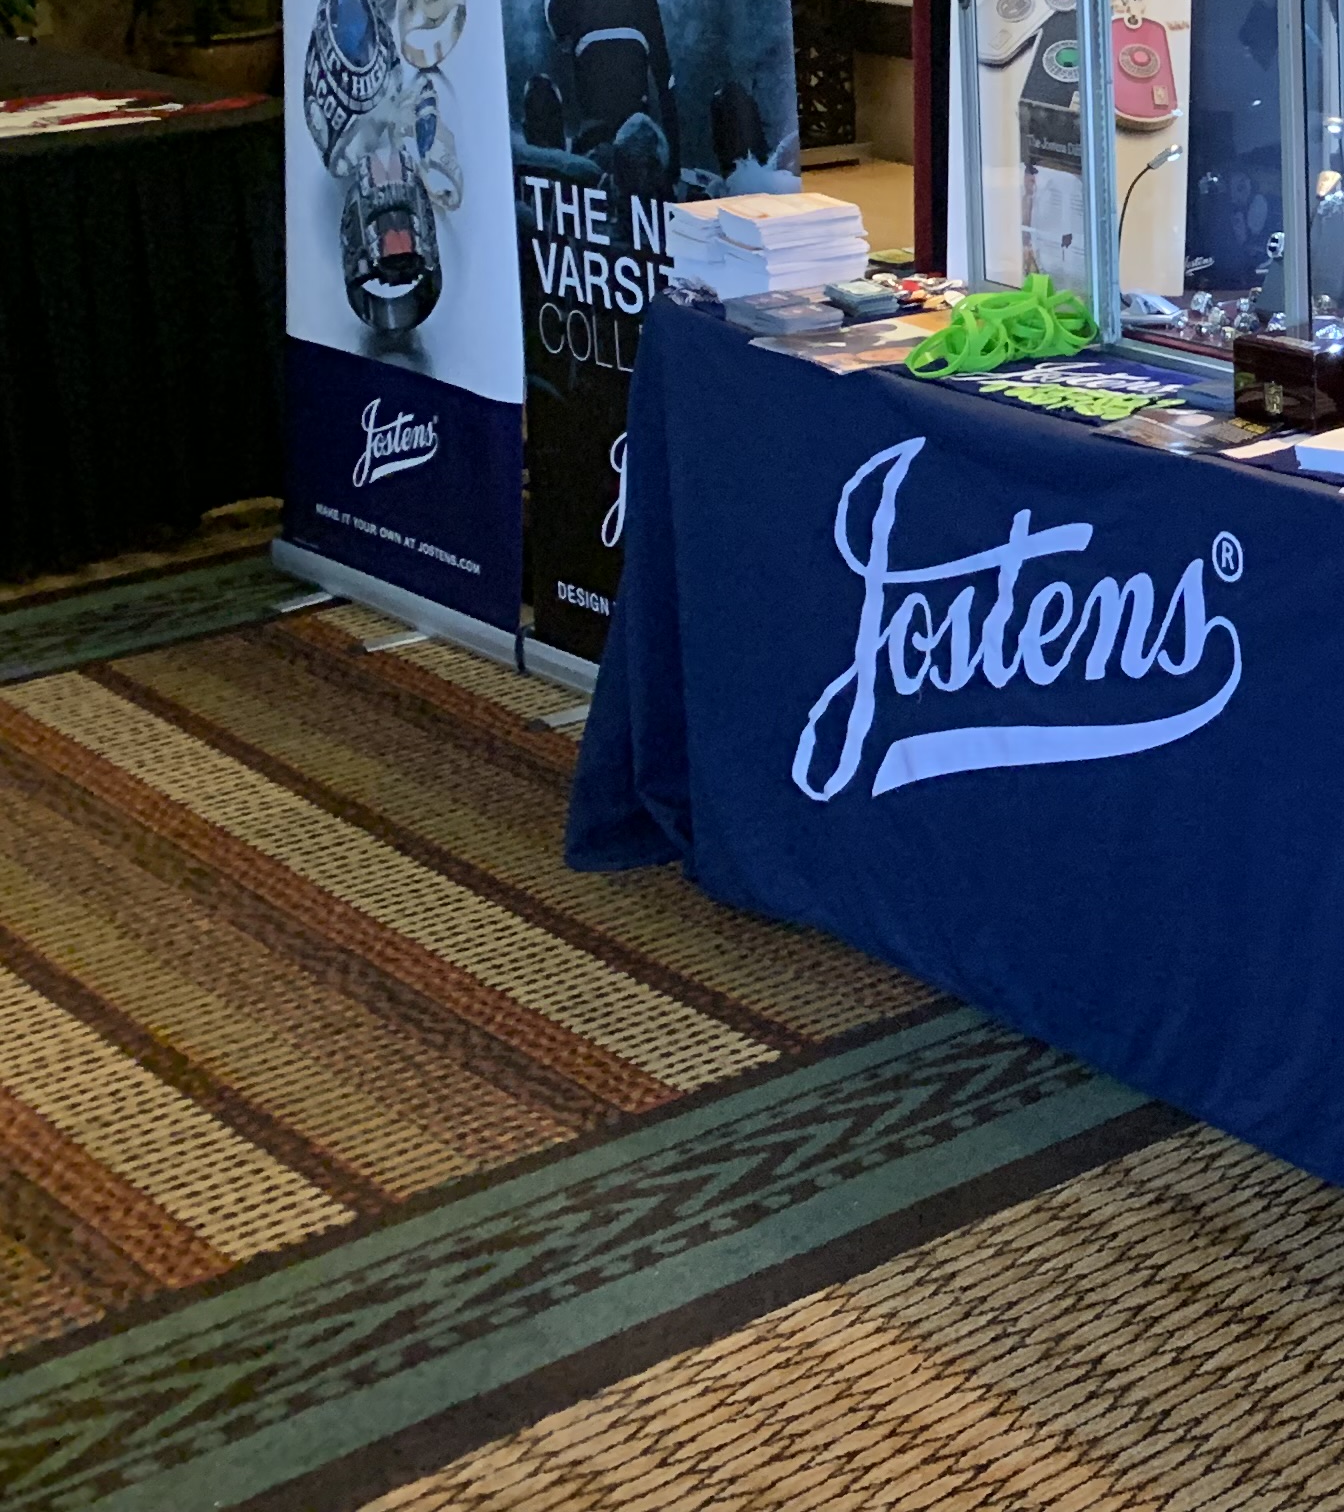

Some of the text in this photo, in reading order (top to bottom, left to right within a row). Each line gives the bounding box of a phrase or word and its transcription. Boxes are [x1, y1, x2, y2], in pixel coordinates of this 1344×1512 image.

[525, 176, 610, 245] THE
[353, 516, 378, 536] YOUR
[379, 526, 402, 546] OWN
[557, 580, 610, 616] DESIGN
